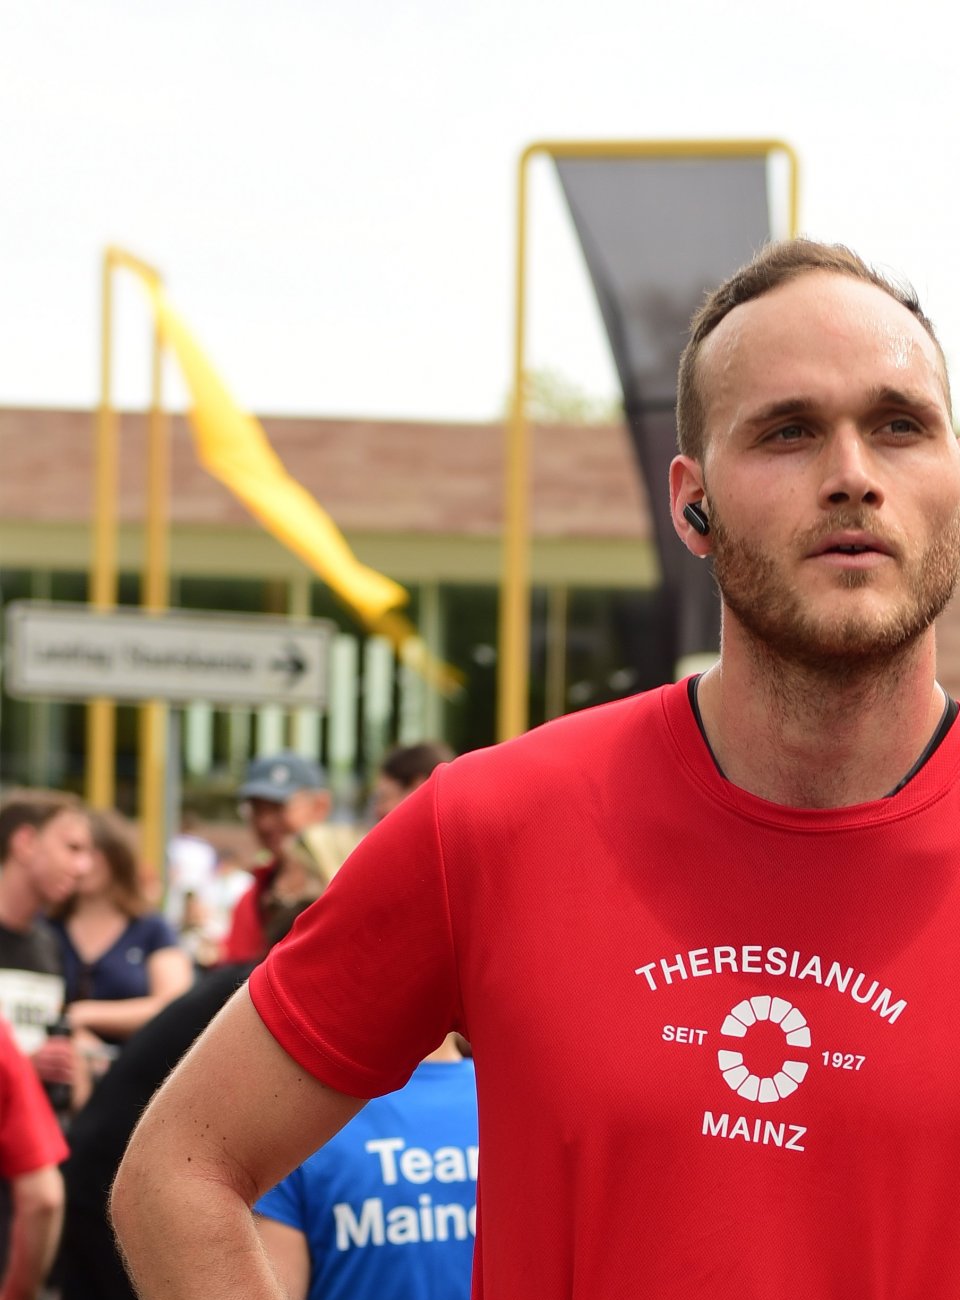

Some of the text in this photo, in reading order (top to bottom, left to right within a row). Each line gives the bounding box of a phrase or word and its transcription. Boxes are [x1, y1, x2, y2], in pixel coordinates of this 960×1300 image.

[635, 945, 907, 1024] THERESIANUM
[661, 1025, 708, 1045] SEIT
[821, 1051, 866, 1071] 1927
[702, 1111, 807, 1151] MAINZ
[366, 1138, 478, 1185] Tea
